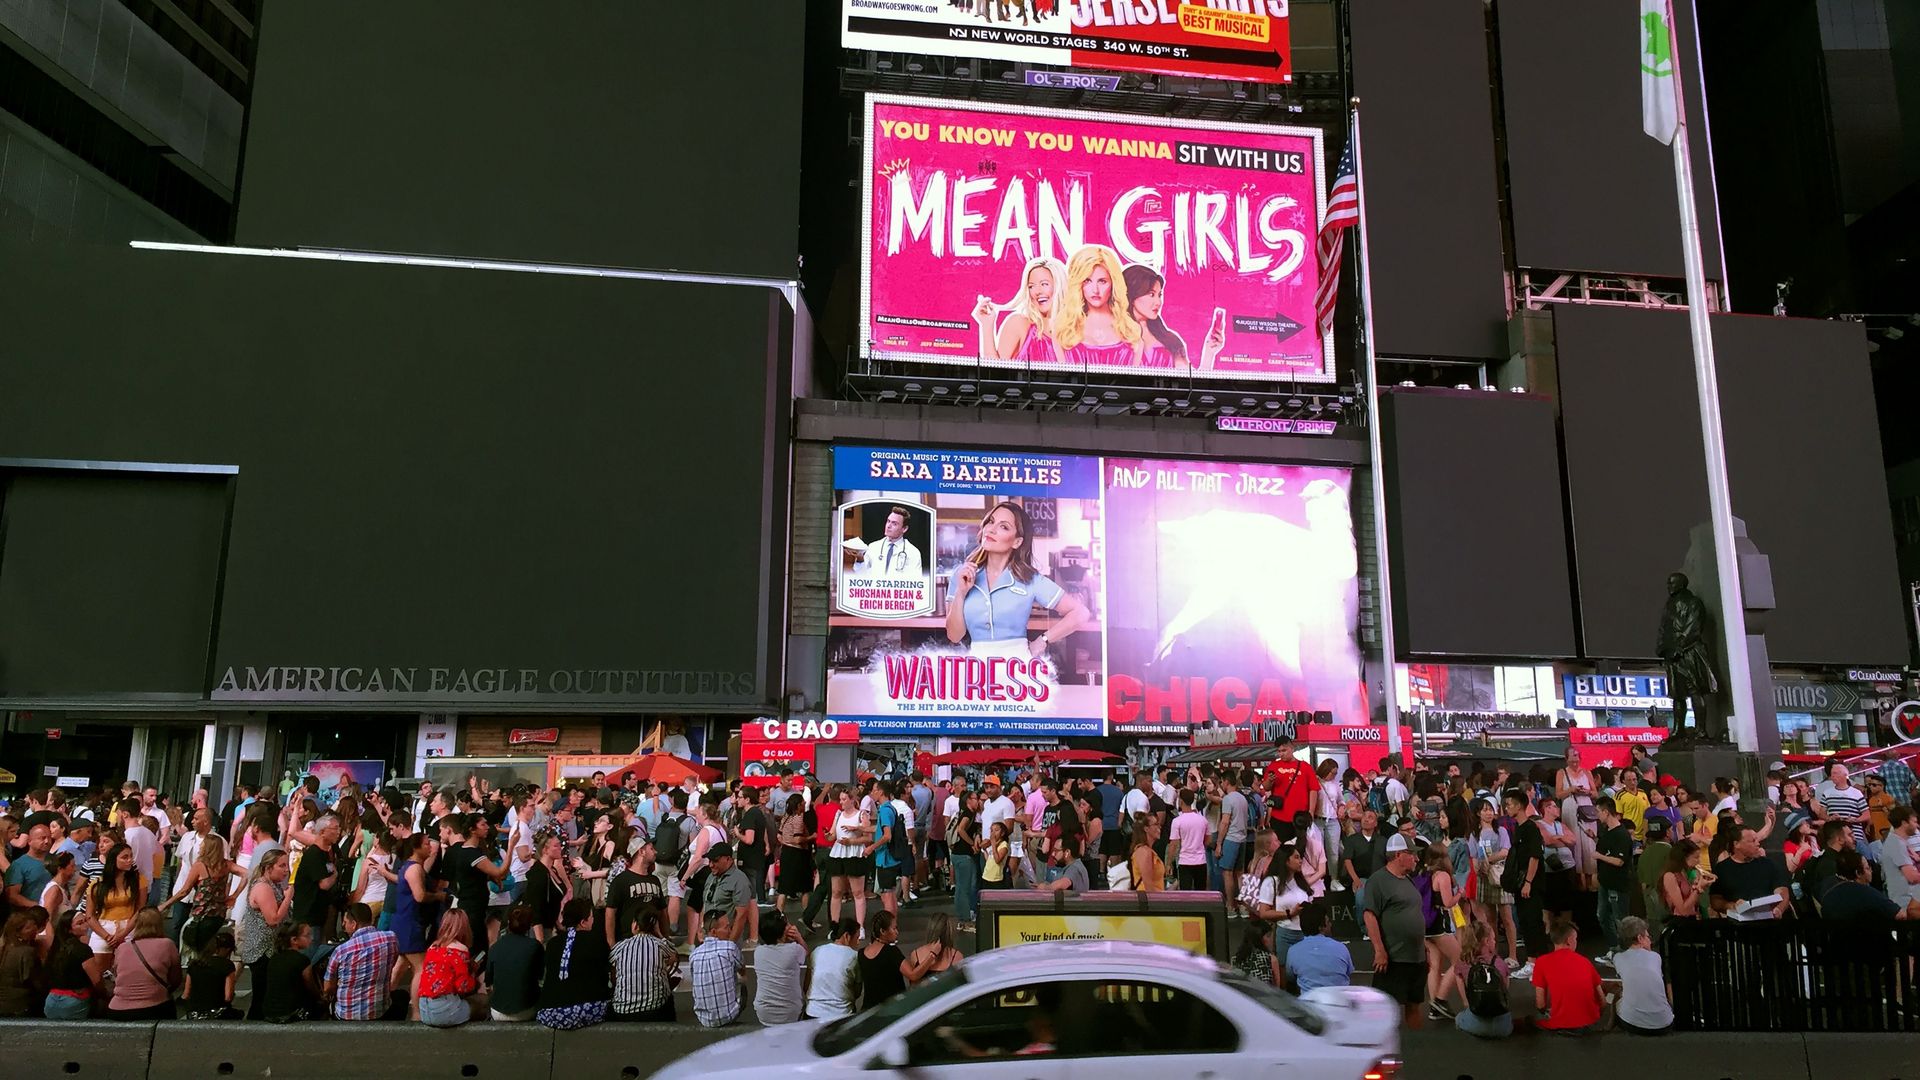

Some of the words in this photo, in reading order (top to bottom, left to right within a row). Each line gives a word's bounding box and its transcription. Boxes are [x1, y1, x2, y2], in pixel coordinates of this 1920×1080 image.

[1183, 15, 1211, 30] BEST
[1214, 19, 1264, 37] MUSICAL
[971, 30, 1000, 40] NEW
[1004, 32, 1049, 45] WORLD
[1052, 36, 1097, 49] STAGES
[1103, 41, 1126, 51] 340
[1129, 44, 1144, 54] W.
[1173, 48, 1189, 58] ST.
[879, 119, 935, 140] YOU
[939, 125, 1016, 147] KNOW
[1024, 131, 1076, 152] YOU
[1081, 135, 1172, 160] WANNA
[1178, 144, 1207, 164] SIT
[1212, 147, 1268, 169] WITH
[1273, 152, 1304, 174] US.
[887, 168, 1087, 262] MEAN
[1109, 184, 1306, 284] GIRLS
[1221, 418, 1290, 431] OUTFRONT
[1297, 422, 1332, 432] PRIME
[870, 452, 911, 460] ORIGINAL
[912, 453, 939, 462] MUSIC
[1024, 458, 1062, 467] NOMINEE
[870, 460, 933, 480] SARA
[942, 464, 1062, 485] BAREILLES
[1113, 466, 1151, 489] AND
[1156, 470, 1185, 491] ALL
[1186, 471, 1232, 493] THAT
[1235, 472, 1286, 496] JAZZ
[1024, 501, 1056, 520] EGGS
[849, 579, 873, 588] NOW
[876, 580, 924, 588] STARRING
[849, 588, 891, 599] SHOSHANA
[894, 589, 914, 600] BEAN
[916, 590, 923, 600] &
[860, 600, 883, 610] ERICH
[885, 600, 915, 610] BERGEN
[216, 666, 418, 693] AMERICAN
[428, 667, 539, 694] EAGLE
[549, 669, 757, 697] OUTFITTERS
[884, 654, 1050, 702] WAITRESS
[1575, 676, 1638, 696] BLUE
[1649, 677, 1669, 696] FI
[897, 703, 916, 711] THE
[918, 703, 935, 711] HIT
[937, 704, 990, 712] BROADWAY
[993, 704, 1036, 712] MUSICAL
[763, 720, 780, 739] C
[786, 720, 838, 739] BAO
[868, 720, 907, 728] ATKINSON
[999, 722, 1098, 731] WAITRESSTHEMUSICAL.COM
[1120, 724, 1161, 733] AMBASSADOR
[1162, 725, 1189, 733] THEATRE
[1341, 728, 1381, 740] HOTDOGS
[1586, 732, 1624, 743] belgian
[1628, 732, 1663, 741] waffles
[1020, 932, 1041, 942] Your
[1043, 932, 1064, 941] kind
[1065, 932, 1076, 940] of
